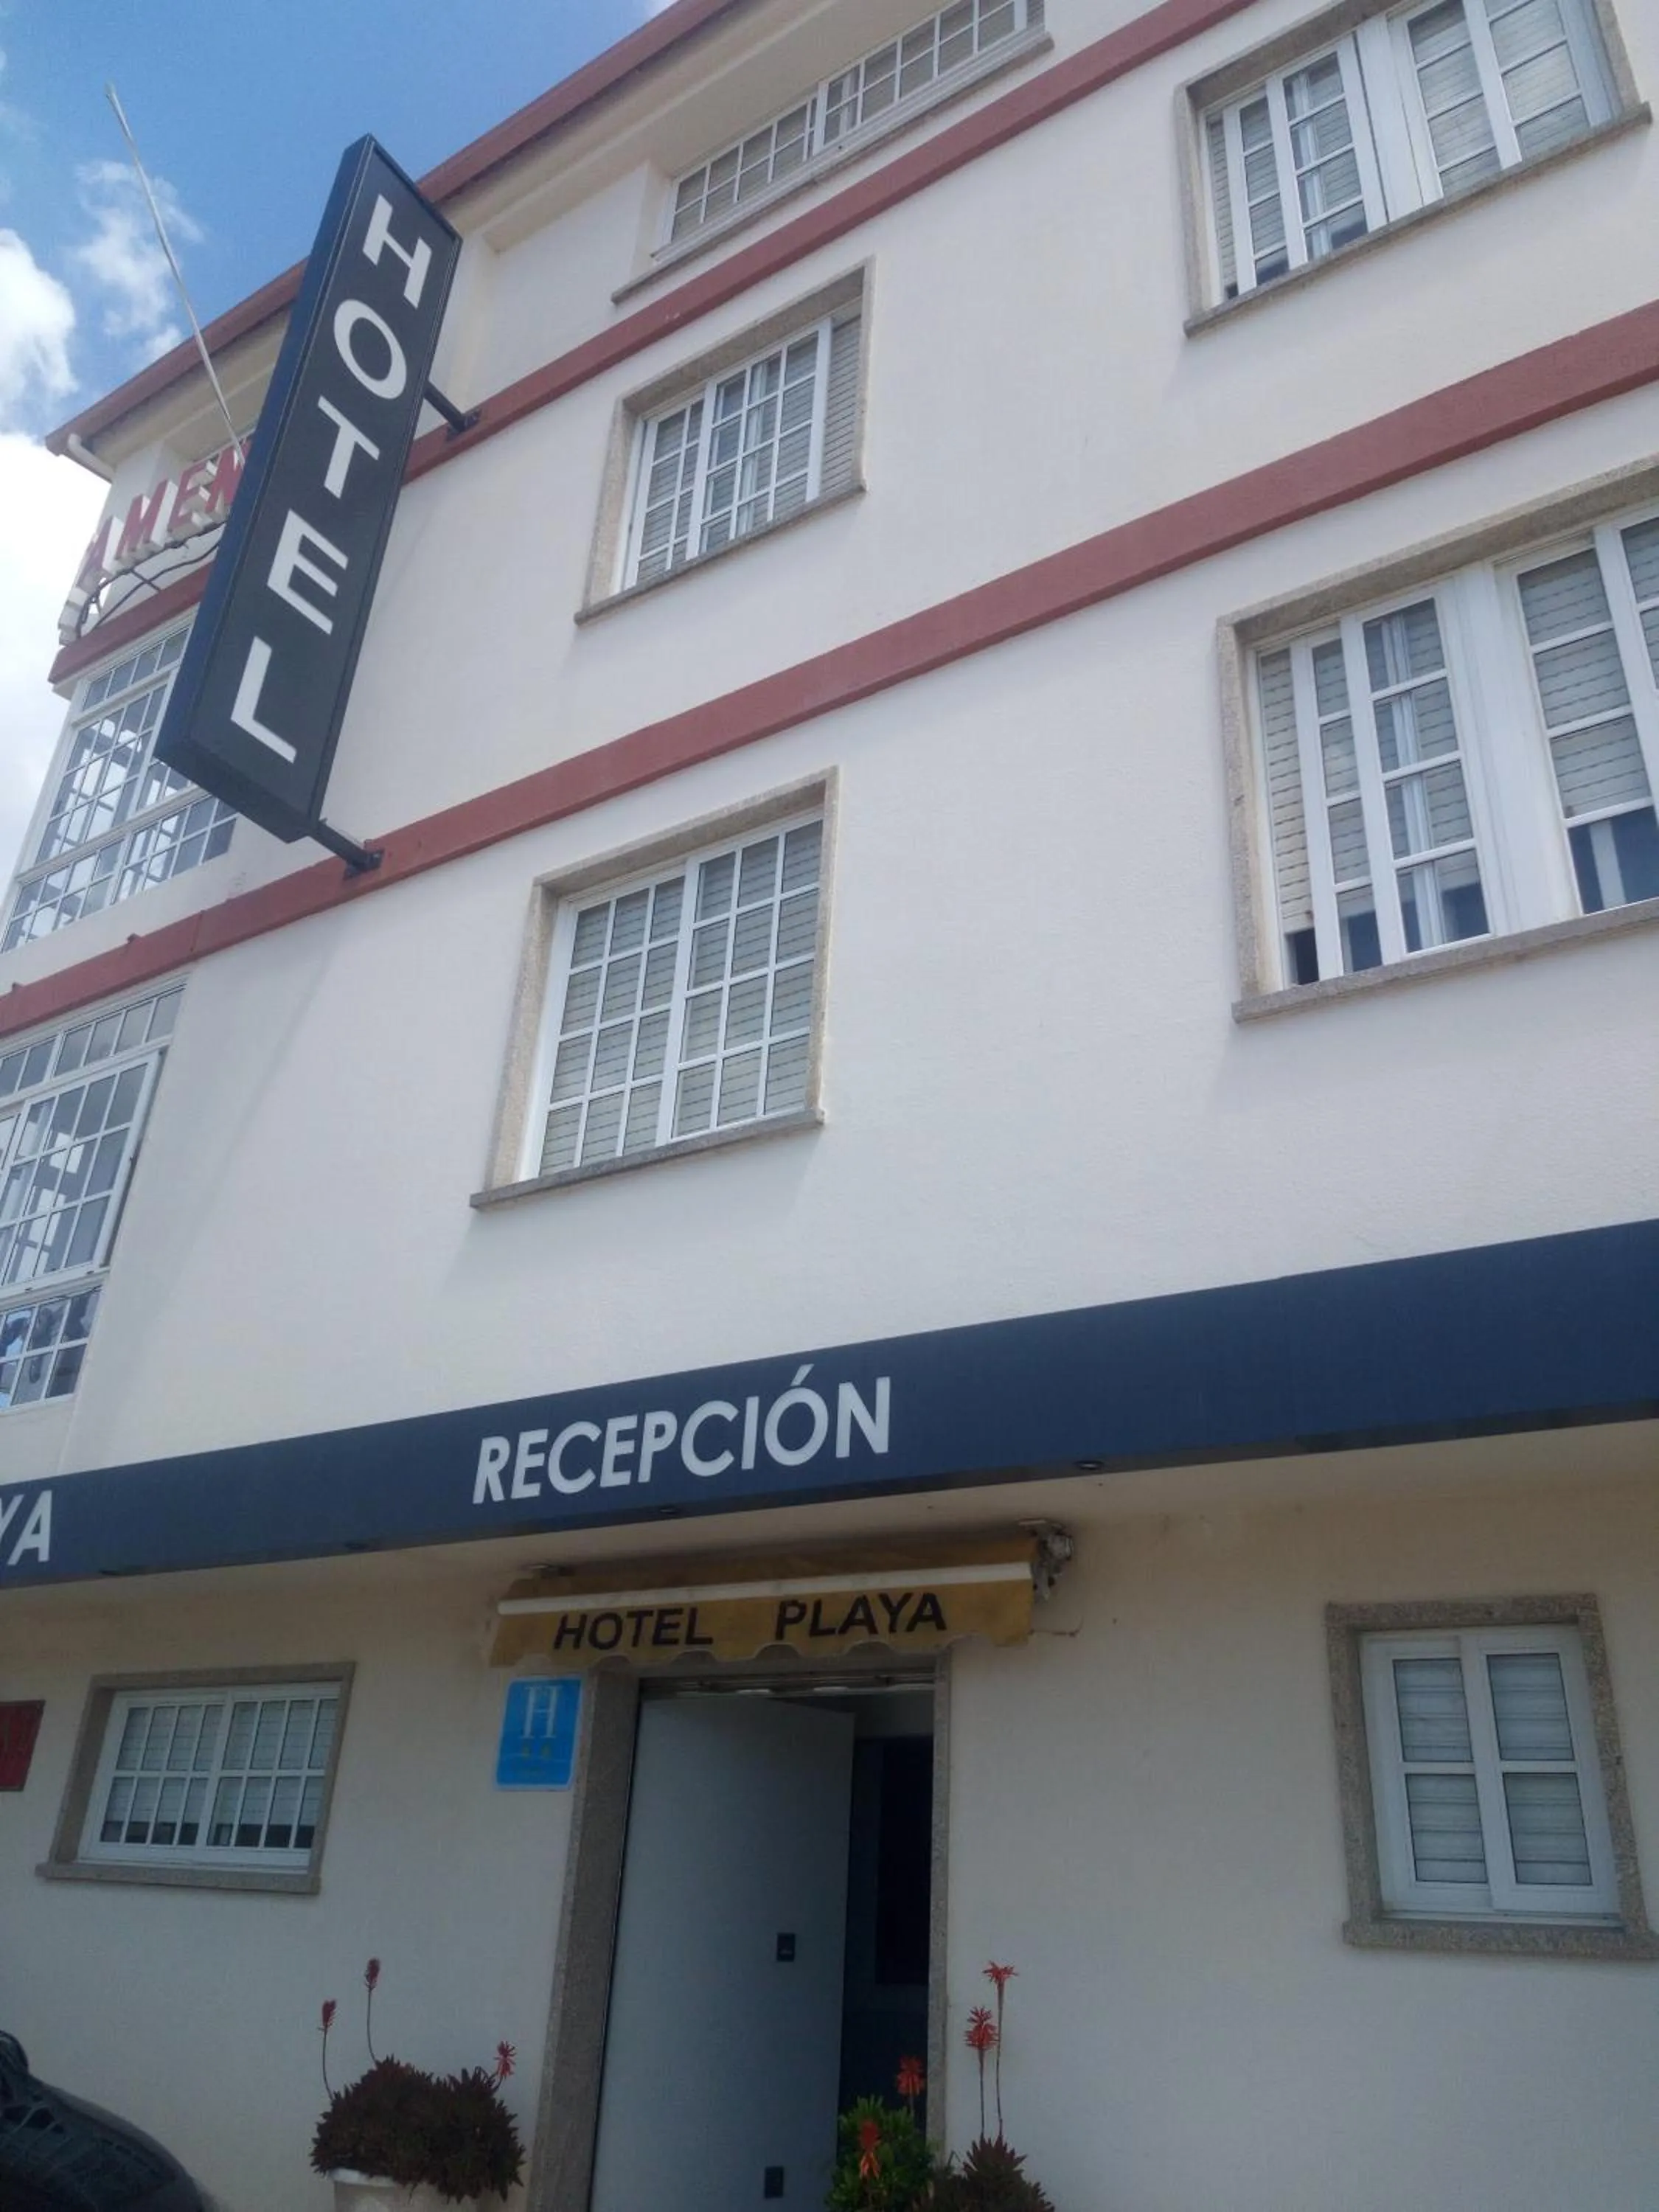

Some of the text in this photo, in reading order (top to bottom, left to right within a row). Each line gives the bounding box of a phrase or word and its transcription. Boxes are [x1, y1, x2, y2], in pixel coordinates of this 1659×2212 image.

[226, 194, 431, 763] HOTEL
[473, 1364, 891, 1505] RECEPCIÓN
[554, 1592, 947, 1650] HOTEL PLAYA
[518, 1686, 563, 1739] H
